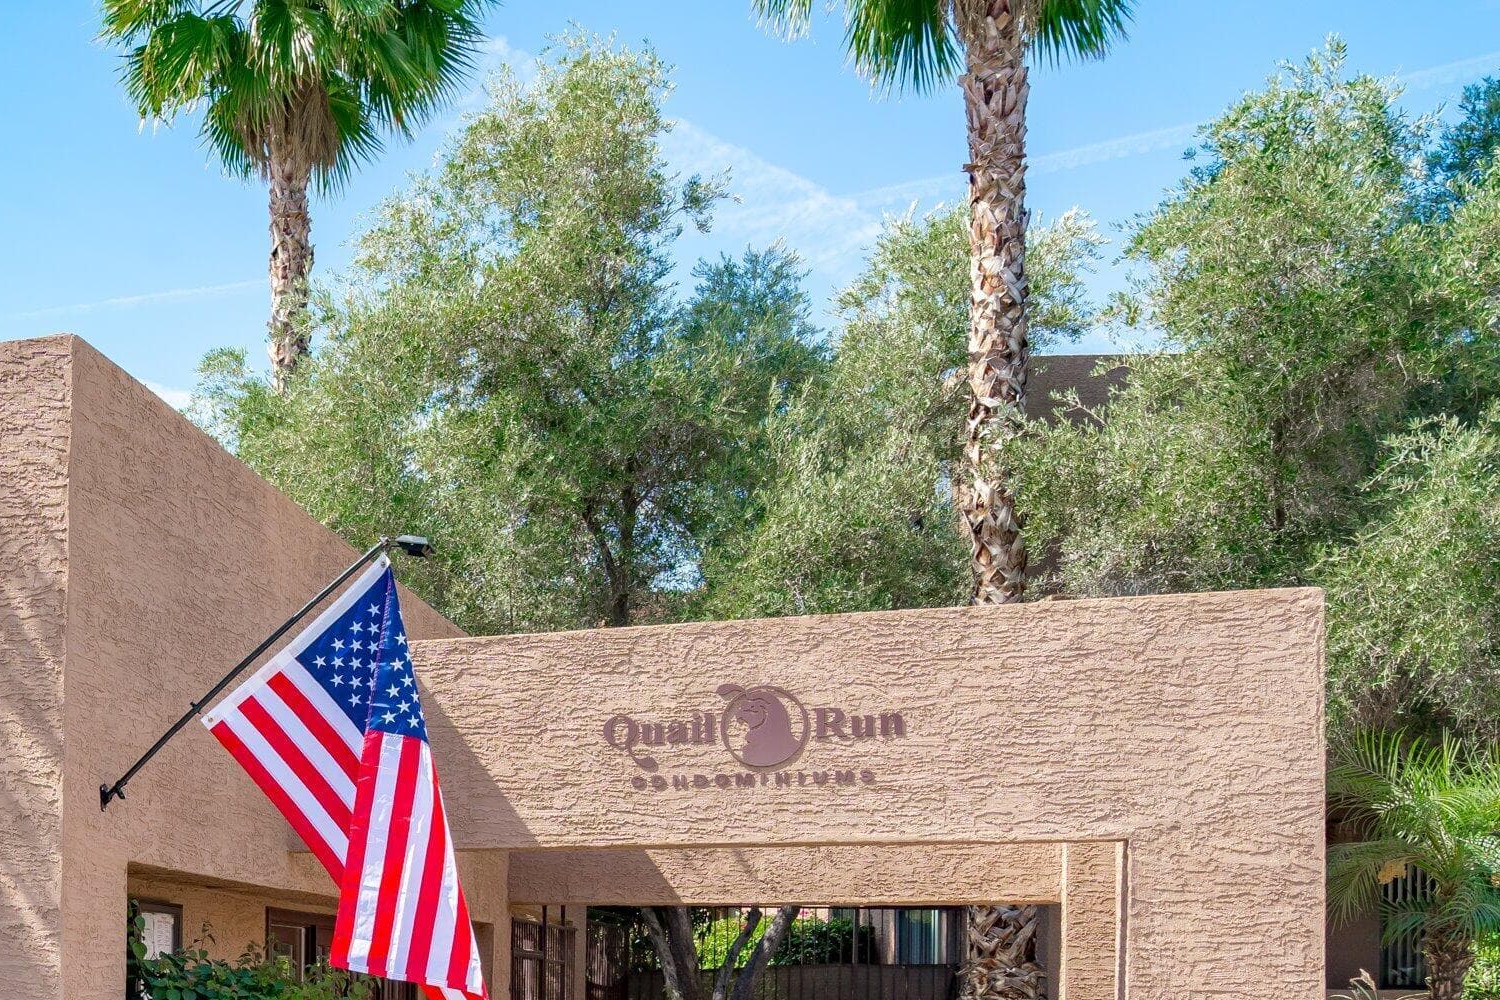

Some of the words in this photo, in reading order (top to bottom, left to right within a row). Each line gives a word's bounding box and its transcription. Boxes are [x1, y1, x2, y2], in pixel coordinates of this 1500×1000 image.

[603, 713, 716, 773] Quail
[814, 707, 906, 740] Run
[630, 769, 876, 792] CONDOMINIUMS
